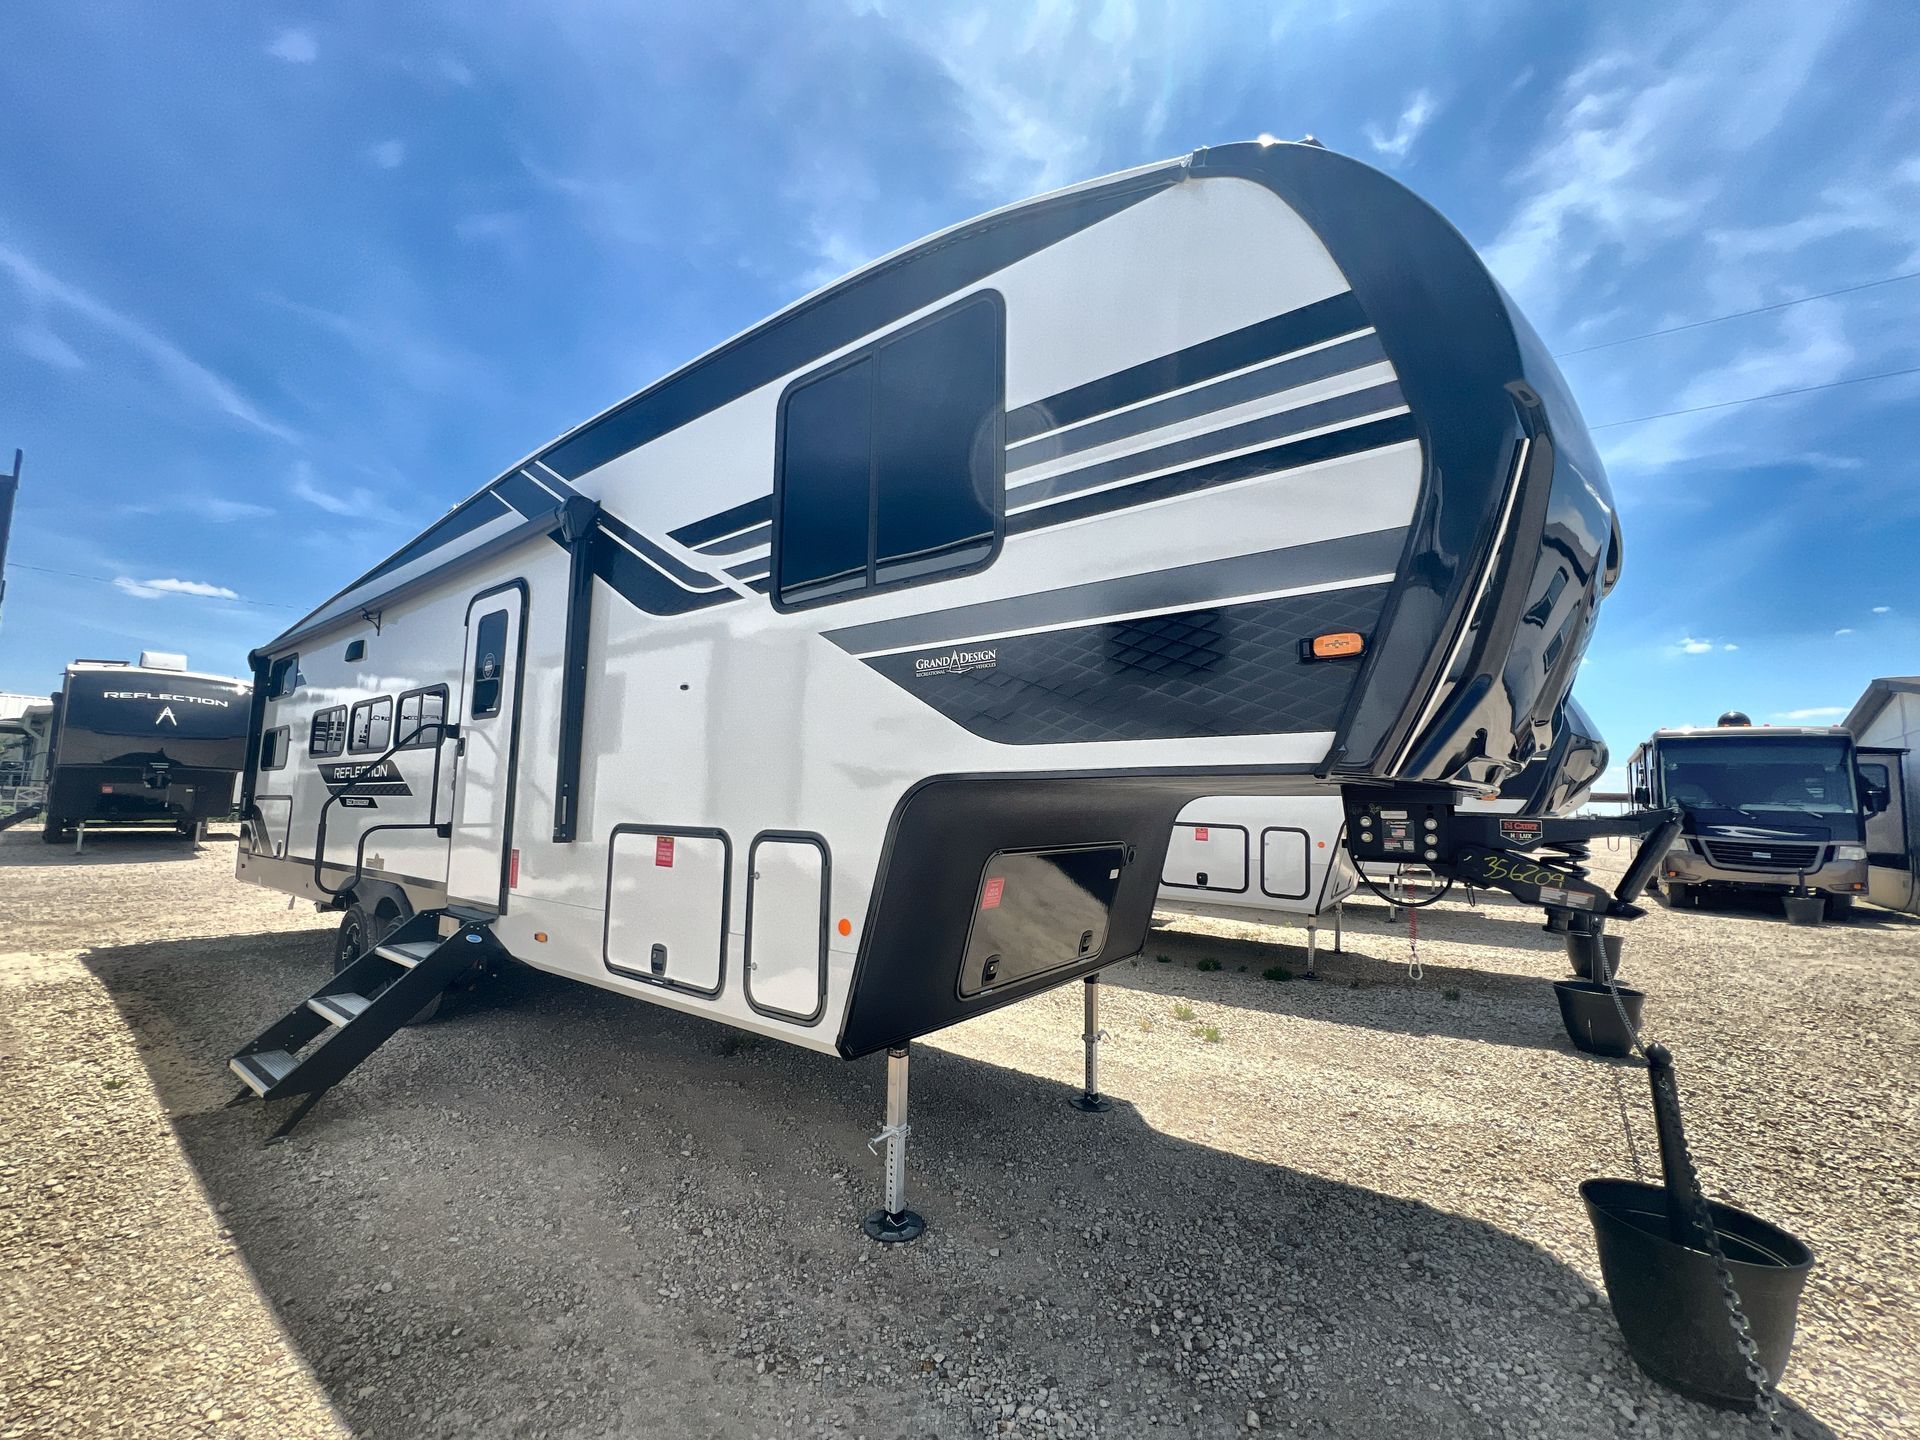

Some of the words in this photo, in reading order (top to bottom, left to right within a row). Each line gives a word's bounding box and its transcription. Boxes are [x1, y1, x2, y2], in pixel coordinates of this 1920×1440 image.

[916, 656, 950, 669] GRAND
[960, 650, 996, 663] DESIGN
[103, 691, 229, 708] REFLECTION
